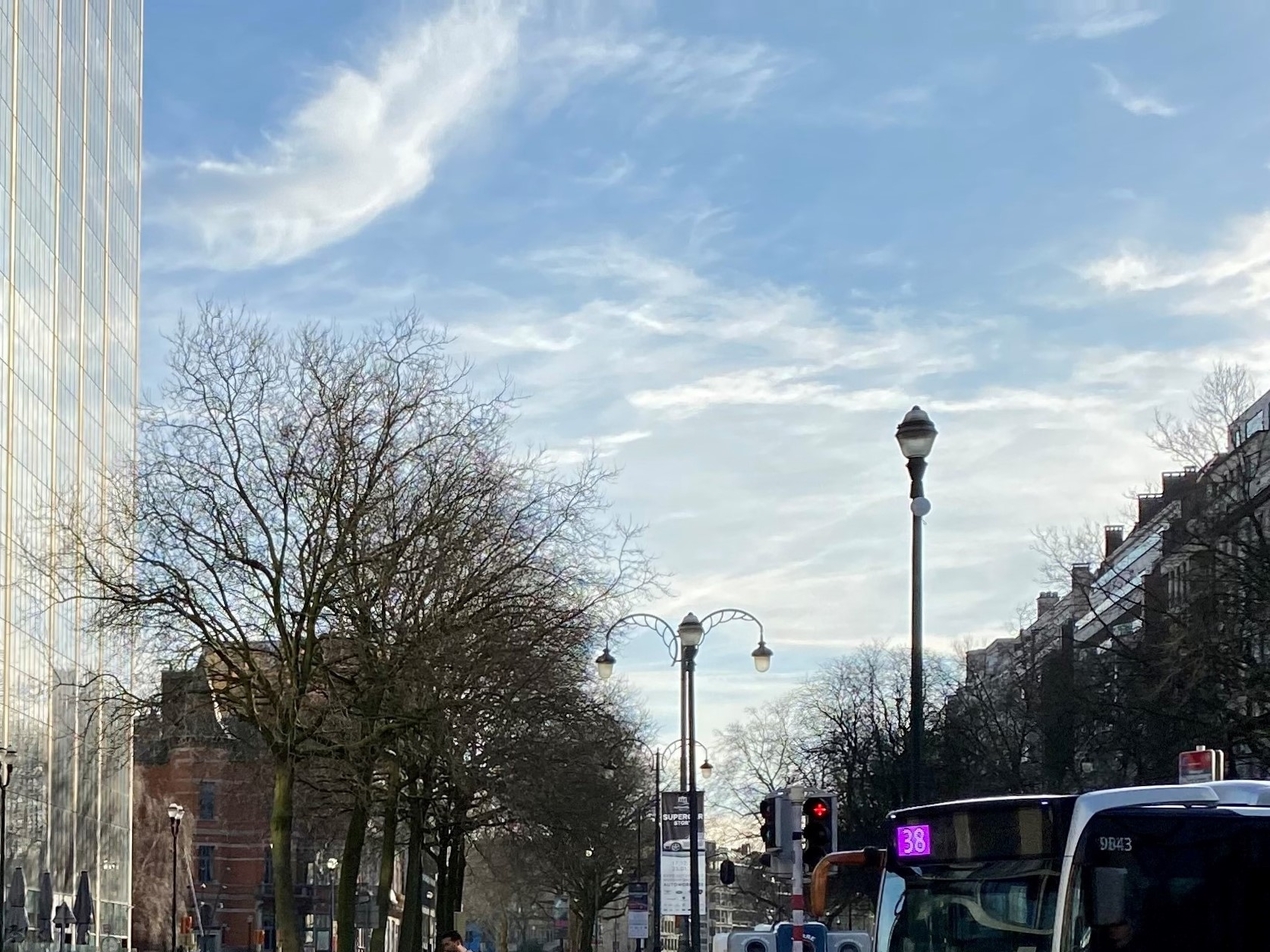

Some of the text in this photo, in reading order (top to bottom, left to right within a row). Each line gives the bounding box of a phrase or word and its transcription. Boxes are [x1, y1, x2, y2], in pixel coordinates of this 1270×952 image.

[662, 813, 704, 821] SUPERCR
[902, 828, 926, 854] 38
[1099, 836, 1132, 852] 9843
